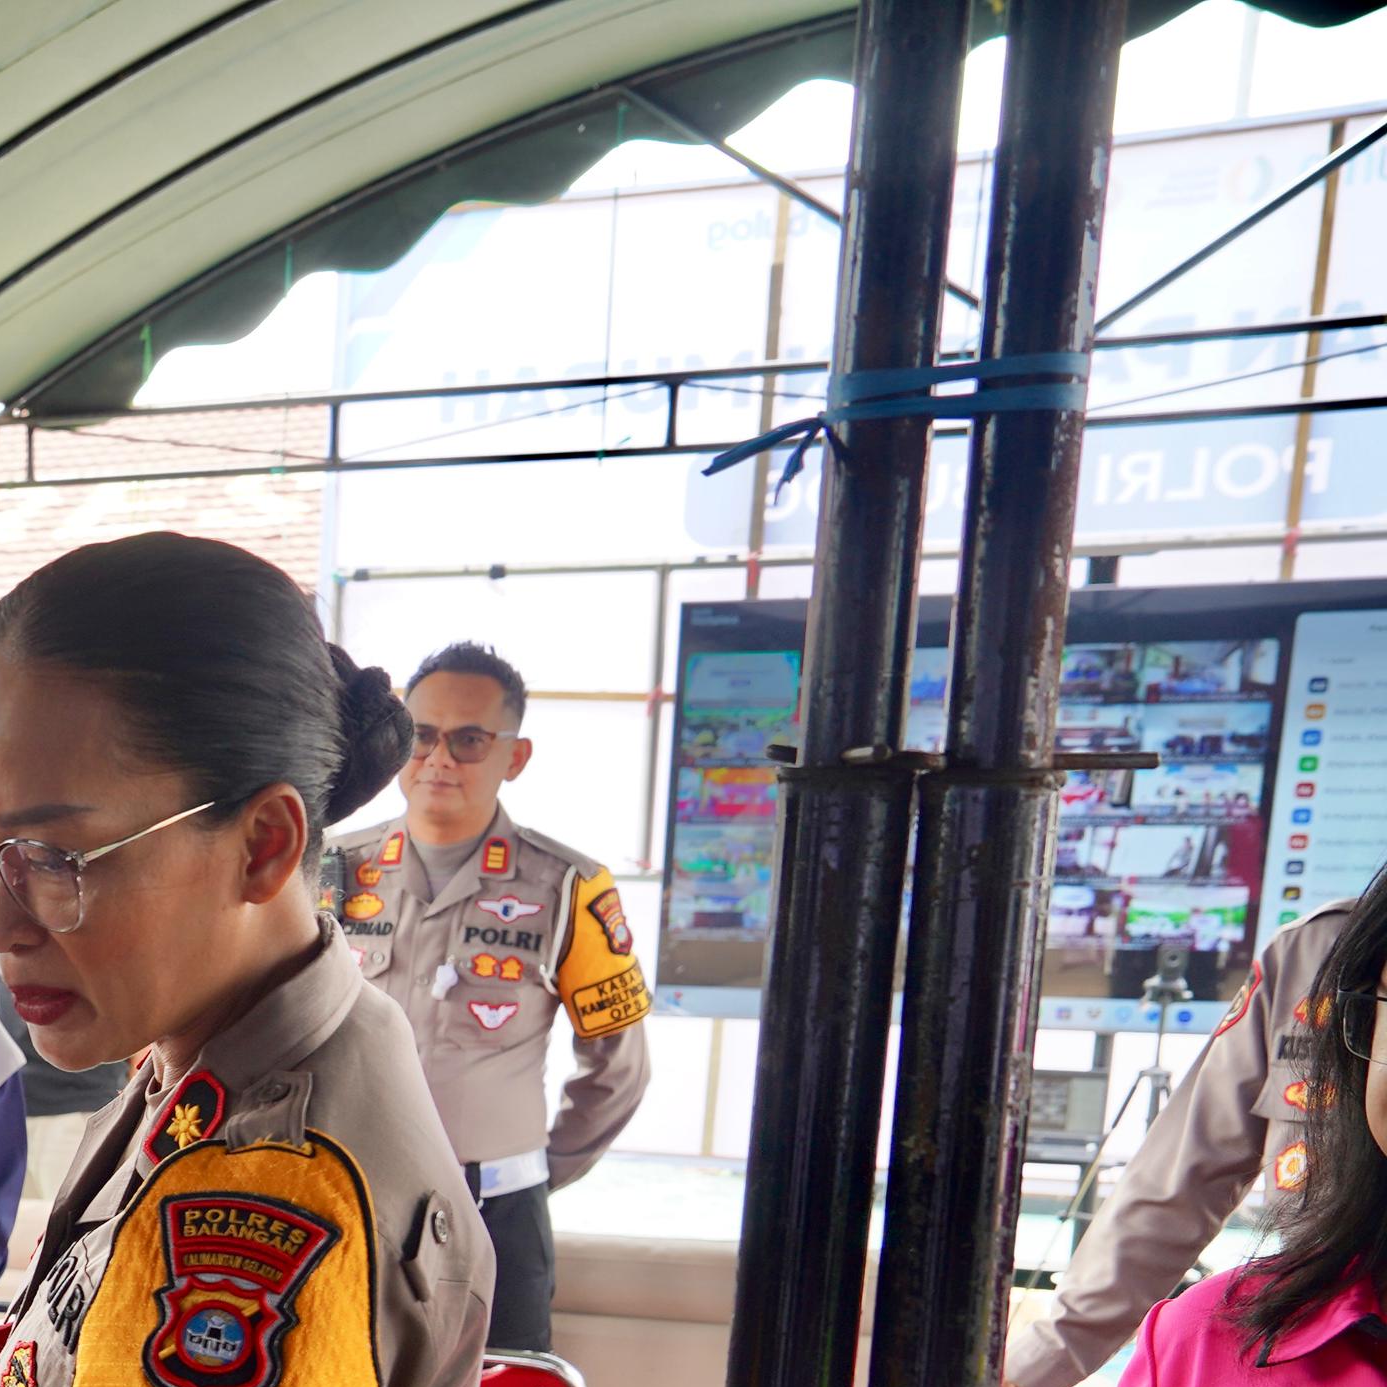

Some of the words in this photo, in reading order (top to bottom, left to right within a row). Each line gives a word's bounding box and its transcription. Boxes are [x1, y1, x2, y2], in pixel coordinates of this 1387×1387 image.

[463, 926, 544, 952] POLRI
[183, 1222, 300, 1255] BALANGAN
[184, 1208, 308, 1245] POLRES
